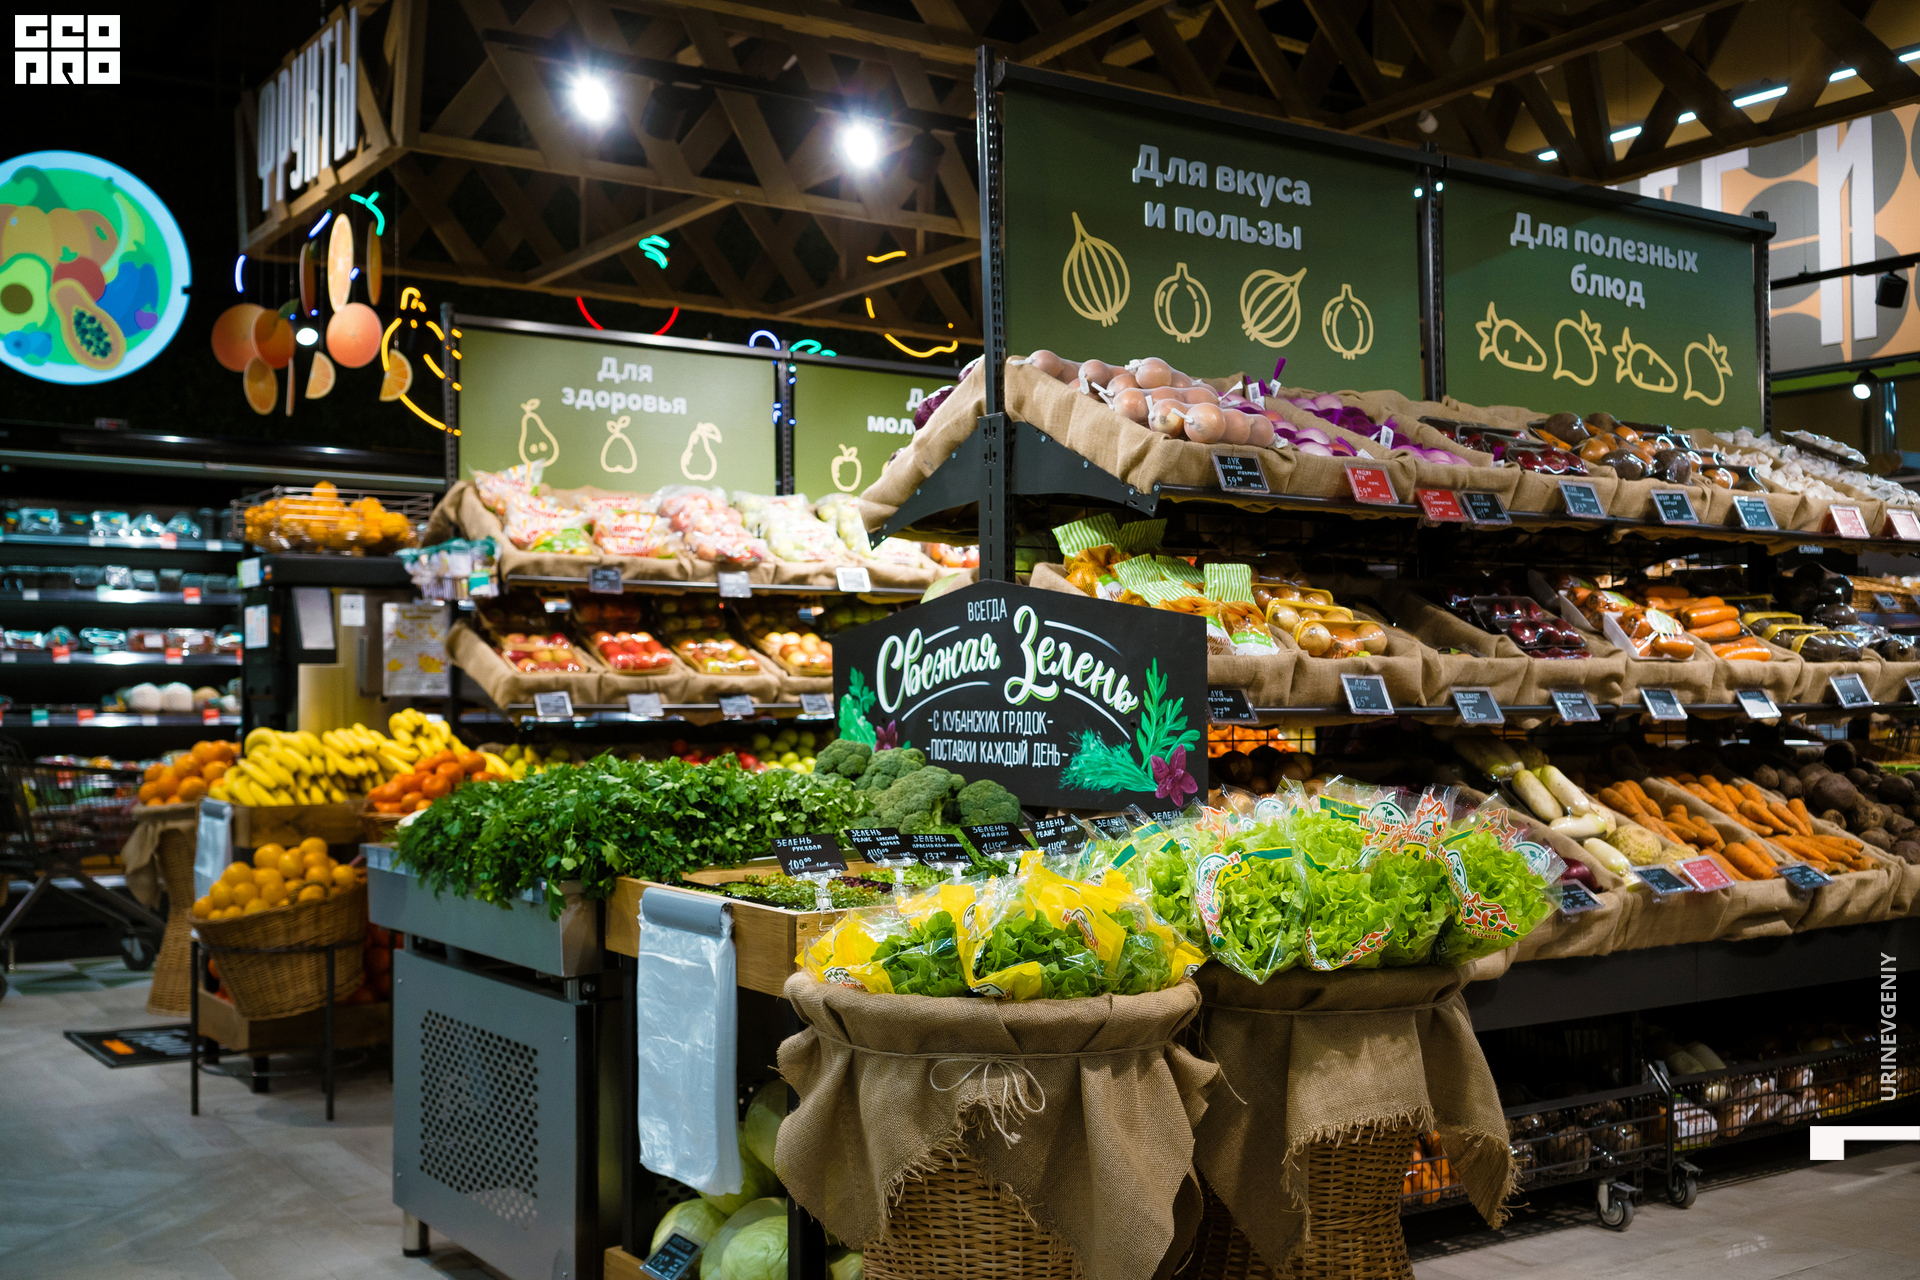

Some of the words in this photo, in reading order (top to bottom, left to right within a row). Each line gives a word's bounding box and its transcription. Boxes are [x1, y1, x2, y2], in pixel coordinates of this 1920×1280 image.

[257, 5, 359, 213] ФРУКТЫ
[1132, 144, 1208, 188] Для
[1216, 165, 1312, 208] вкуса
[1144, 201, 1166, 228] и
[1175, 206, 1302, 251] пользы
[1510, 212, 1568, 250] Для
[1574, 228, 1699, 273] полезных
[1570, 263, 1646, 309] блюд
[597, 356, 653, 384] Для
[561, 386, 687, 415] здоровья
[1227, 457, 1240, 465] ЛУК
[1798, 544, 1824, 554] СЛОЙКИ
[967, 598, 1008, 622] ВСЕГДА
[876, 627, 1001, 714] Свежая
[1004, 605, 1139, 714] Зелень
[942, 710, 1000, 733] КУБАНСКИХ
[979, 739, 1028, 767] КАЖДЫЙ
[1035, 818, 1065, 829] ЗЕЛЕНЬ
[1152, 810, 1183, 820] ЗЕЛЕНЬ
[850, 829, 882, 837] ЗЕЛЕНЬ
[913, 834, 947, 843] ЗЕЛЕНЬ
[972, 824, 1007, 833] ЗЕЛЕНЬ
[1036, 829, 1055, 838] РЕДИС
[1061, 825, 1079, 833] САНГО
[775, 837, 812, 847] ЗЕЛЕНЬ
[792, 844, 822, 852] РУККОЛА
